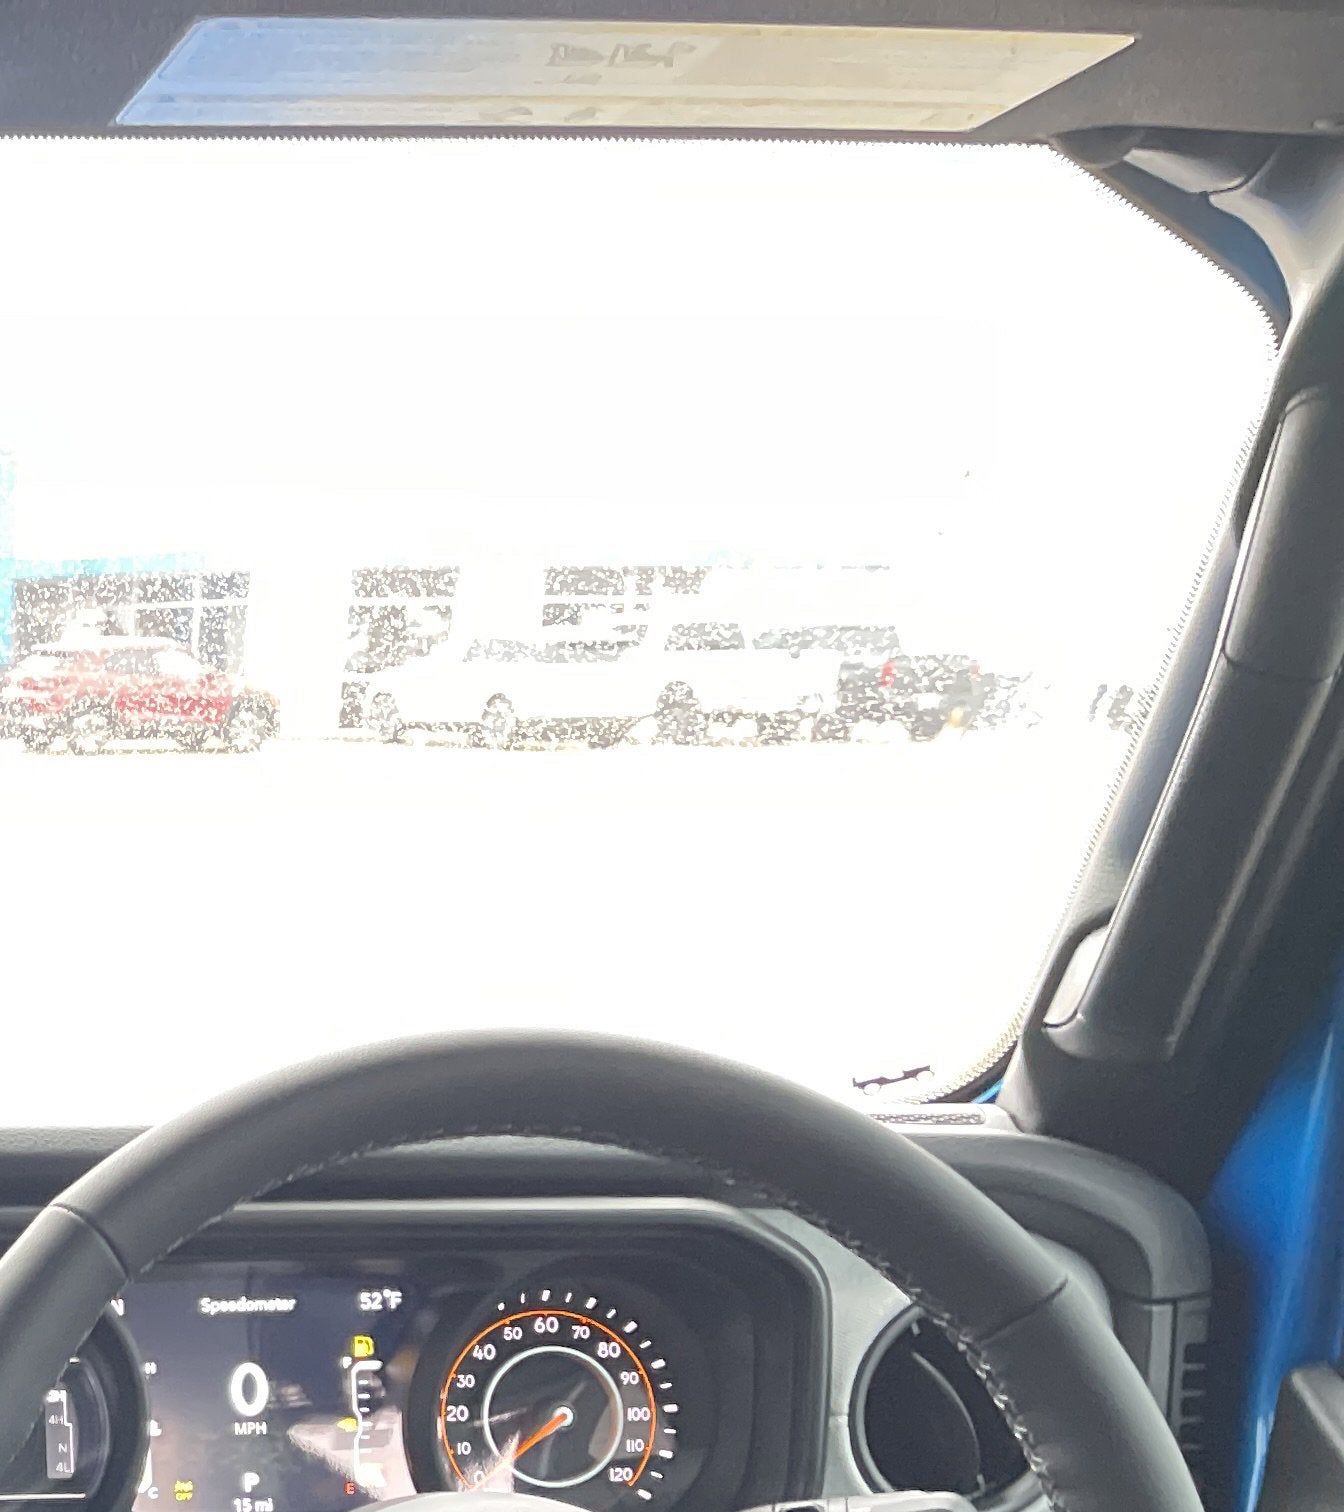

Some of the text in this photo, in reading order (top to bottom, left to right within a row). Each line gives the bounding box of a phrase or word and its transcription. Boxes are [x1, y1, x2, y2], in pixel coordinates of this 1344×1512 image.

[200, 1296, 296, 1315] Speedometer
[534, 1316, 559, 1333] 60
[503, 1326, 523, 1340] 50
[571, 1325, 590, 1339] 70
[473, 1343, 497, 1360] 40
[597, 1341, 621, 1358] 80
[456, 1374, 475, 1388] 30
[620, 1371, 639, 1385] 90
[230, 1361, 269, 1417] 0
[48, 1415, 64, 1425] 4H
[446, 1405, 469, 1421] 20
[627, 1407, 650, 1421] 100
[234, 1422, 266, 1435] MPH
[58, 1443, 68, 1453] N
[456, 1442, 472, 1455] 10
[626, 1439, 645, 1452] 110
[56, 1462, 71, 1473] 4L
[609, 1467, 633, 1482] 120
[242, 1472, 260, 1493] P
[148, 1487, 159, 1499] C
[233, 1497, 274, 1512] 15 mi
